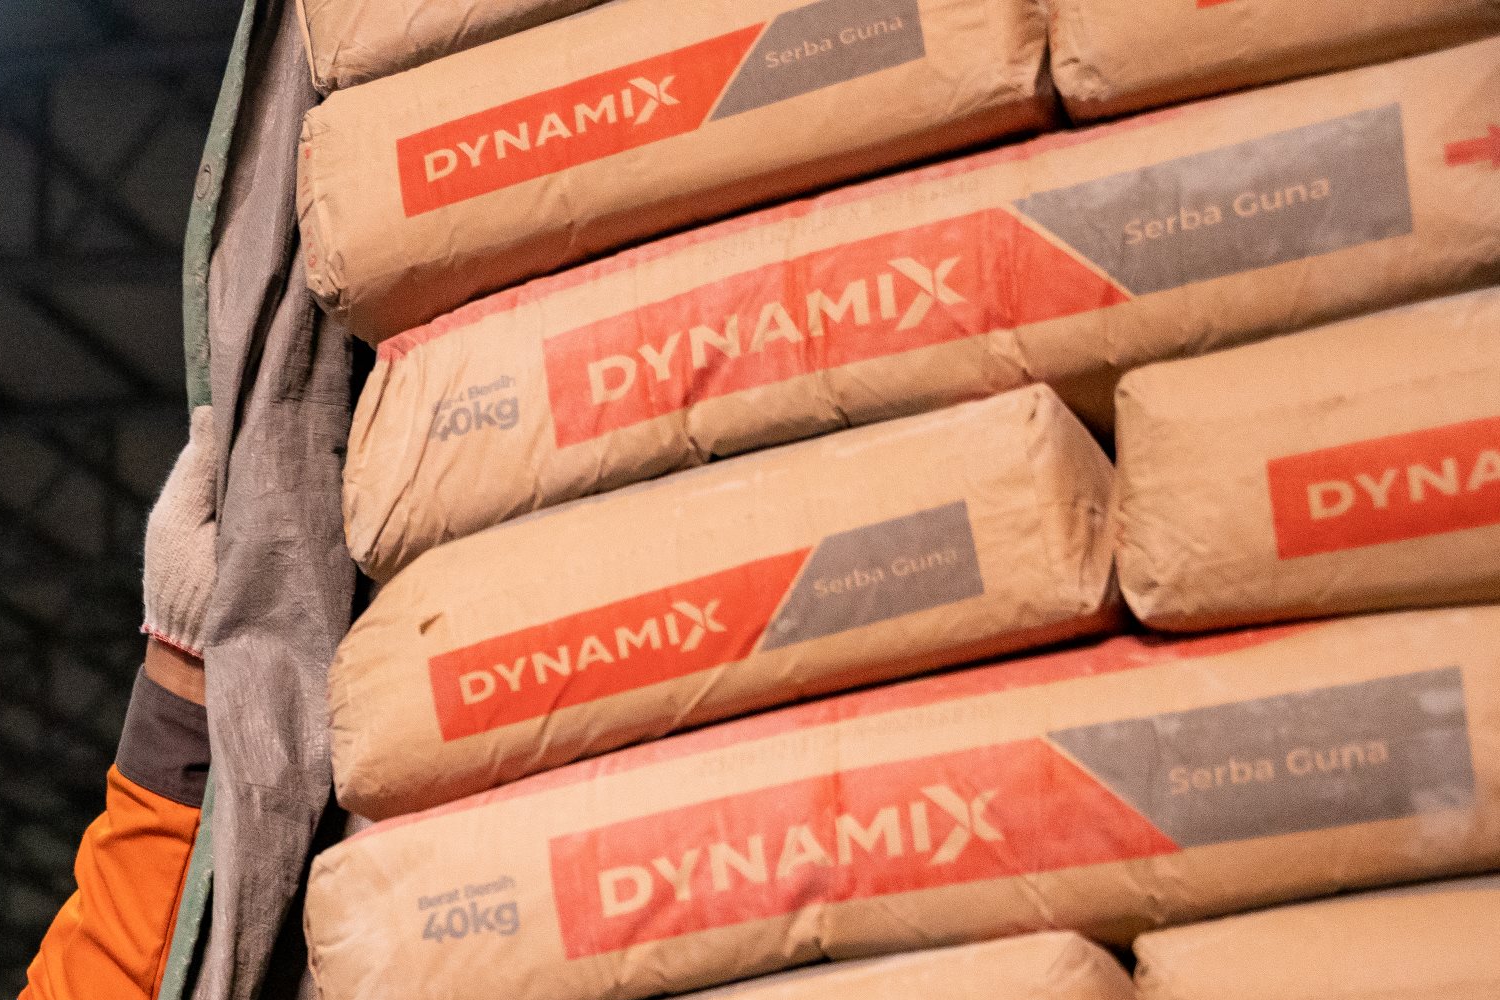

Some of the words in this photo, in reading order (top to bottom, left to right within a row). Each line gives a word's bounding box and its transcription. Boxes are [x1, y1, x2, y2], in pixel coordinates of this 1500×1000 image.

[424, 75, 681, 183] DYNAMIX
[764, 36, 833, 70] Serba
[839, 15, 902, 46] Guna
[588, 256, 970, 406] DYNAMIX
[1123, 199, 1222, 246] Serba
[1233, 174, 1331, 218] Guna
[430, 396, 519, 442] 40kg
[1307, 450, 1500, 520] DYNA
[459, 600, 728, 706] DYNAMIX
[813, 566, 883, 599] Serba
[891, 547, 959, 577] Guna
[598, 785, 1004, 919] DYNAMIX
[1169, 757, 1273, 796] Serba
[1286, 737, 1388, 775] Guna
[422, 901, 519, 943] 40kg
